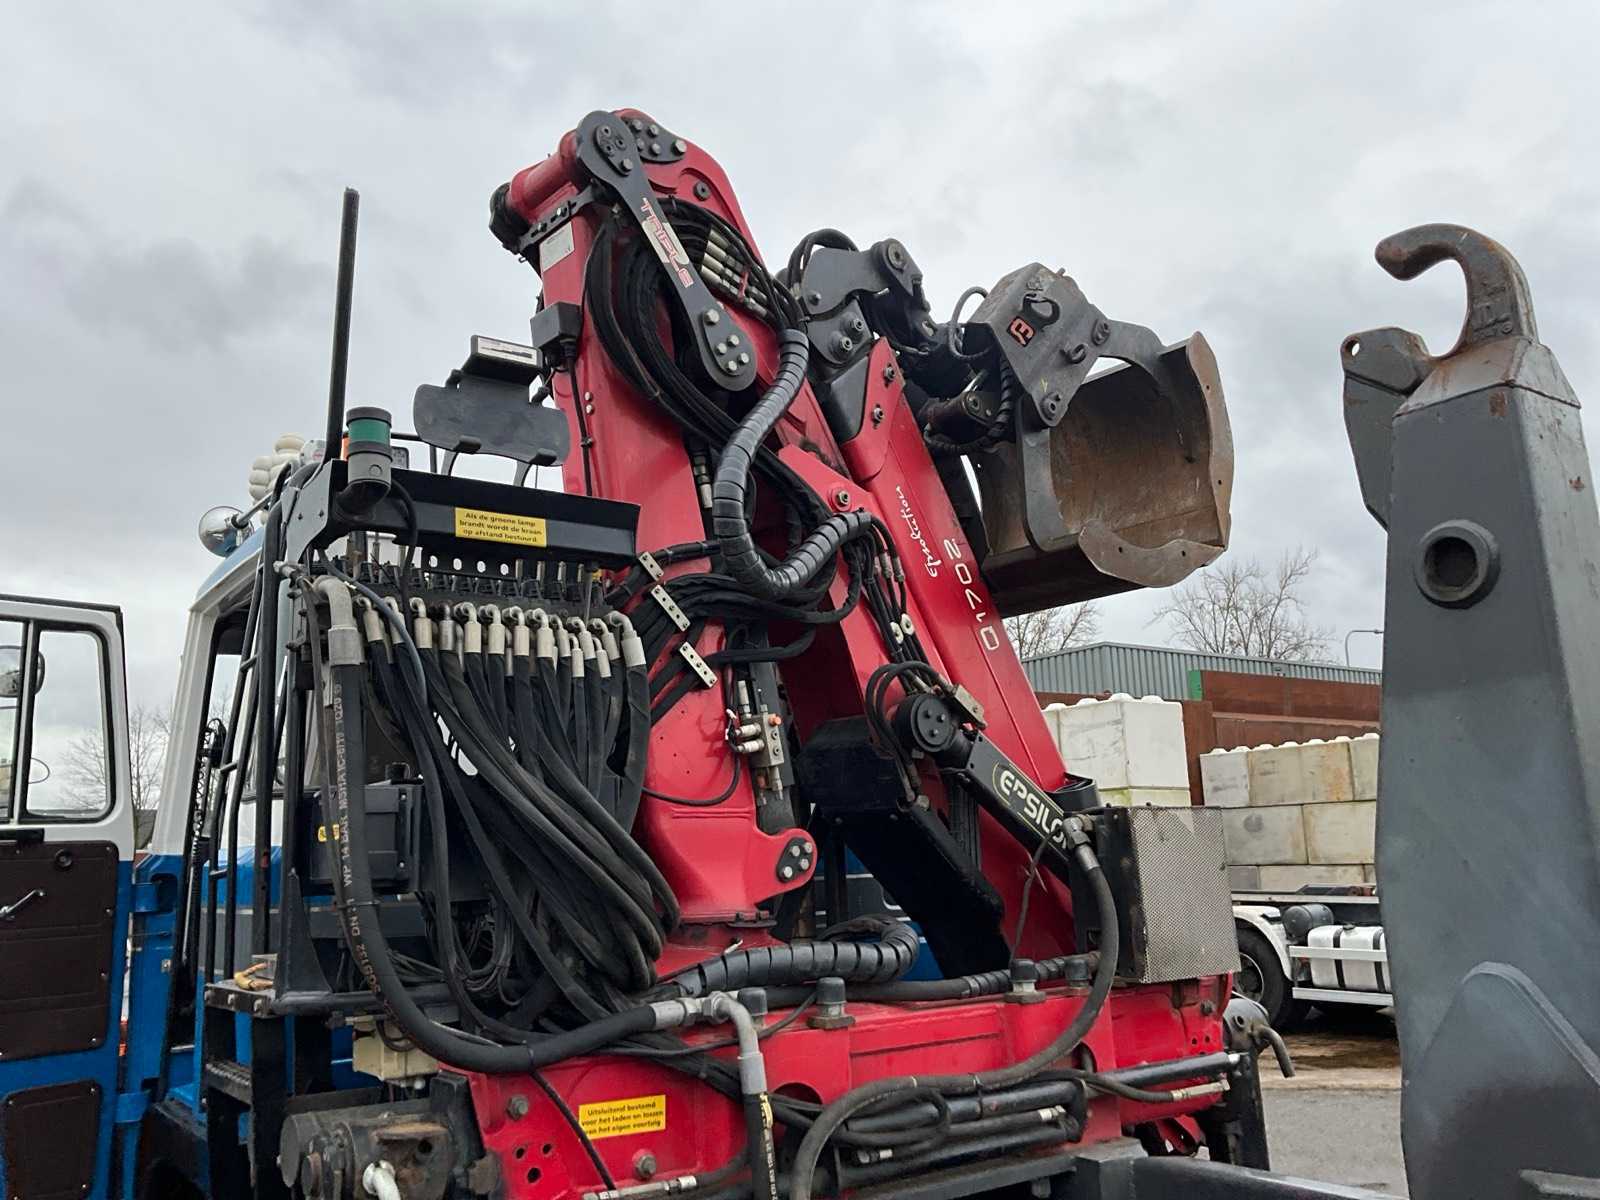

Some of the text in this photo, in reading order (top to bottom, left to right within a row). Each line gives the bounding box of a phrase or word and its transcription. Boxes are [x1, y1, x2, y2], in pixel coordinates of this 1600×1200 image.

[641, 197, 694, 288] TRIPLE
[459, 520, 485, 530] brandt
[486, 523, 509, 532] wordt
[465, 512, 478, 520] Als
[490, 515, 516, 525] groene
[517, 519, 536, 528] lamp
[463, 529, 473, 537] op
[474, 530, 503, 539] afstand
[587, 1102, 657, 1117] Uitsluitend bestemd
[598, 1116, 611, 1124] het
[612, 1113, 632, 1122] laden
[643, 1110, 664, 1119] lossen
[598, 1125, 611, 1134] het
[612, 1123, 631, 1133] eigen
[632, 1119, 661, 1129] voertuig
